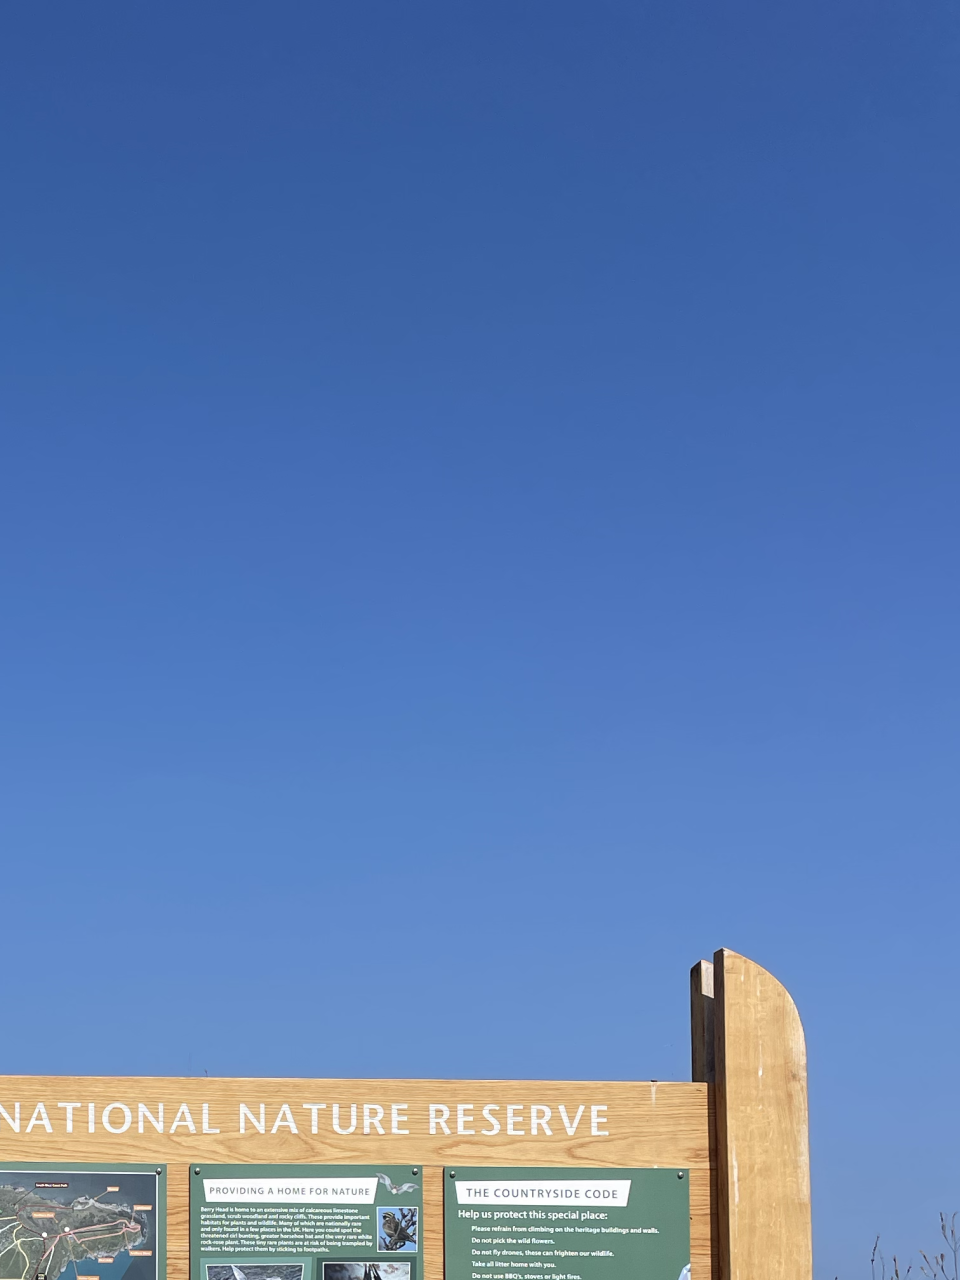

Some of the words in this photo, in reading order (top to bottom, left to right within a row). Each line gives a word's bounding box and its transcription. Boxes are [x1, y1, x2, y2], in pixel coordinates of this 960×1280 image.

[239, 1103, 409, 1134] NATURE
[429, 1104, 609, 1136] RESERVE
[466, 1188, 489, 1198] THE
[493, 1188, 580, 1199] COUNTRYSIDE
[584, 1189, 618, 1199] CODE
[458, 1209, 480, 1220] Help
[494, 1211, 527, 1220] protect
[528, 1210, 546, 1219] this
[548, 1210, 579, 1221] special
